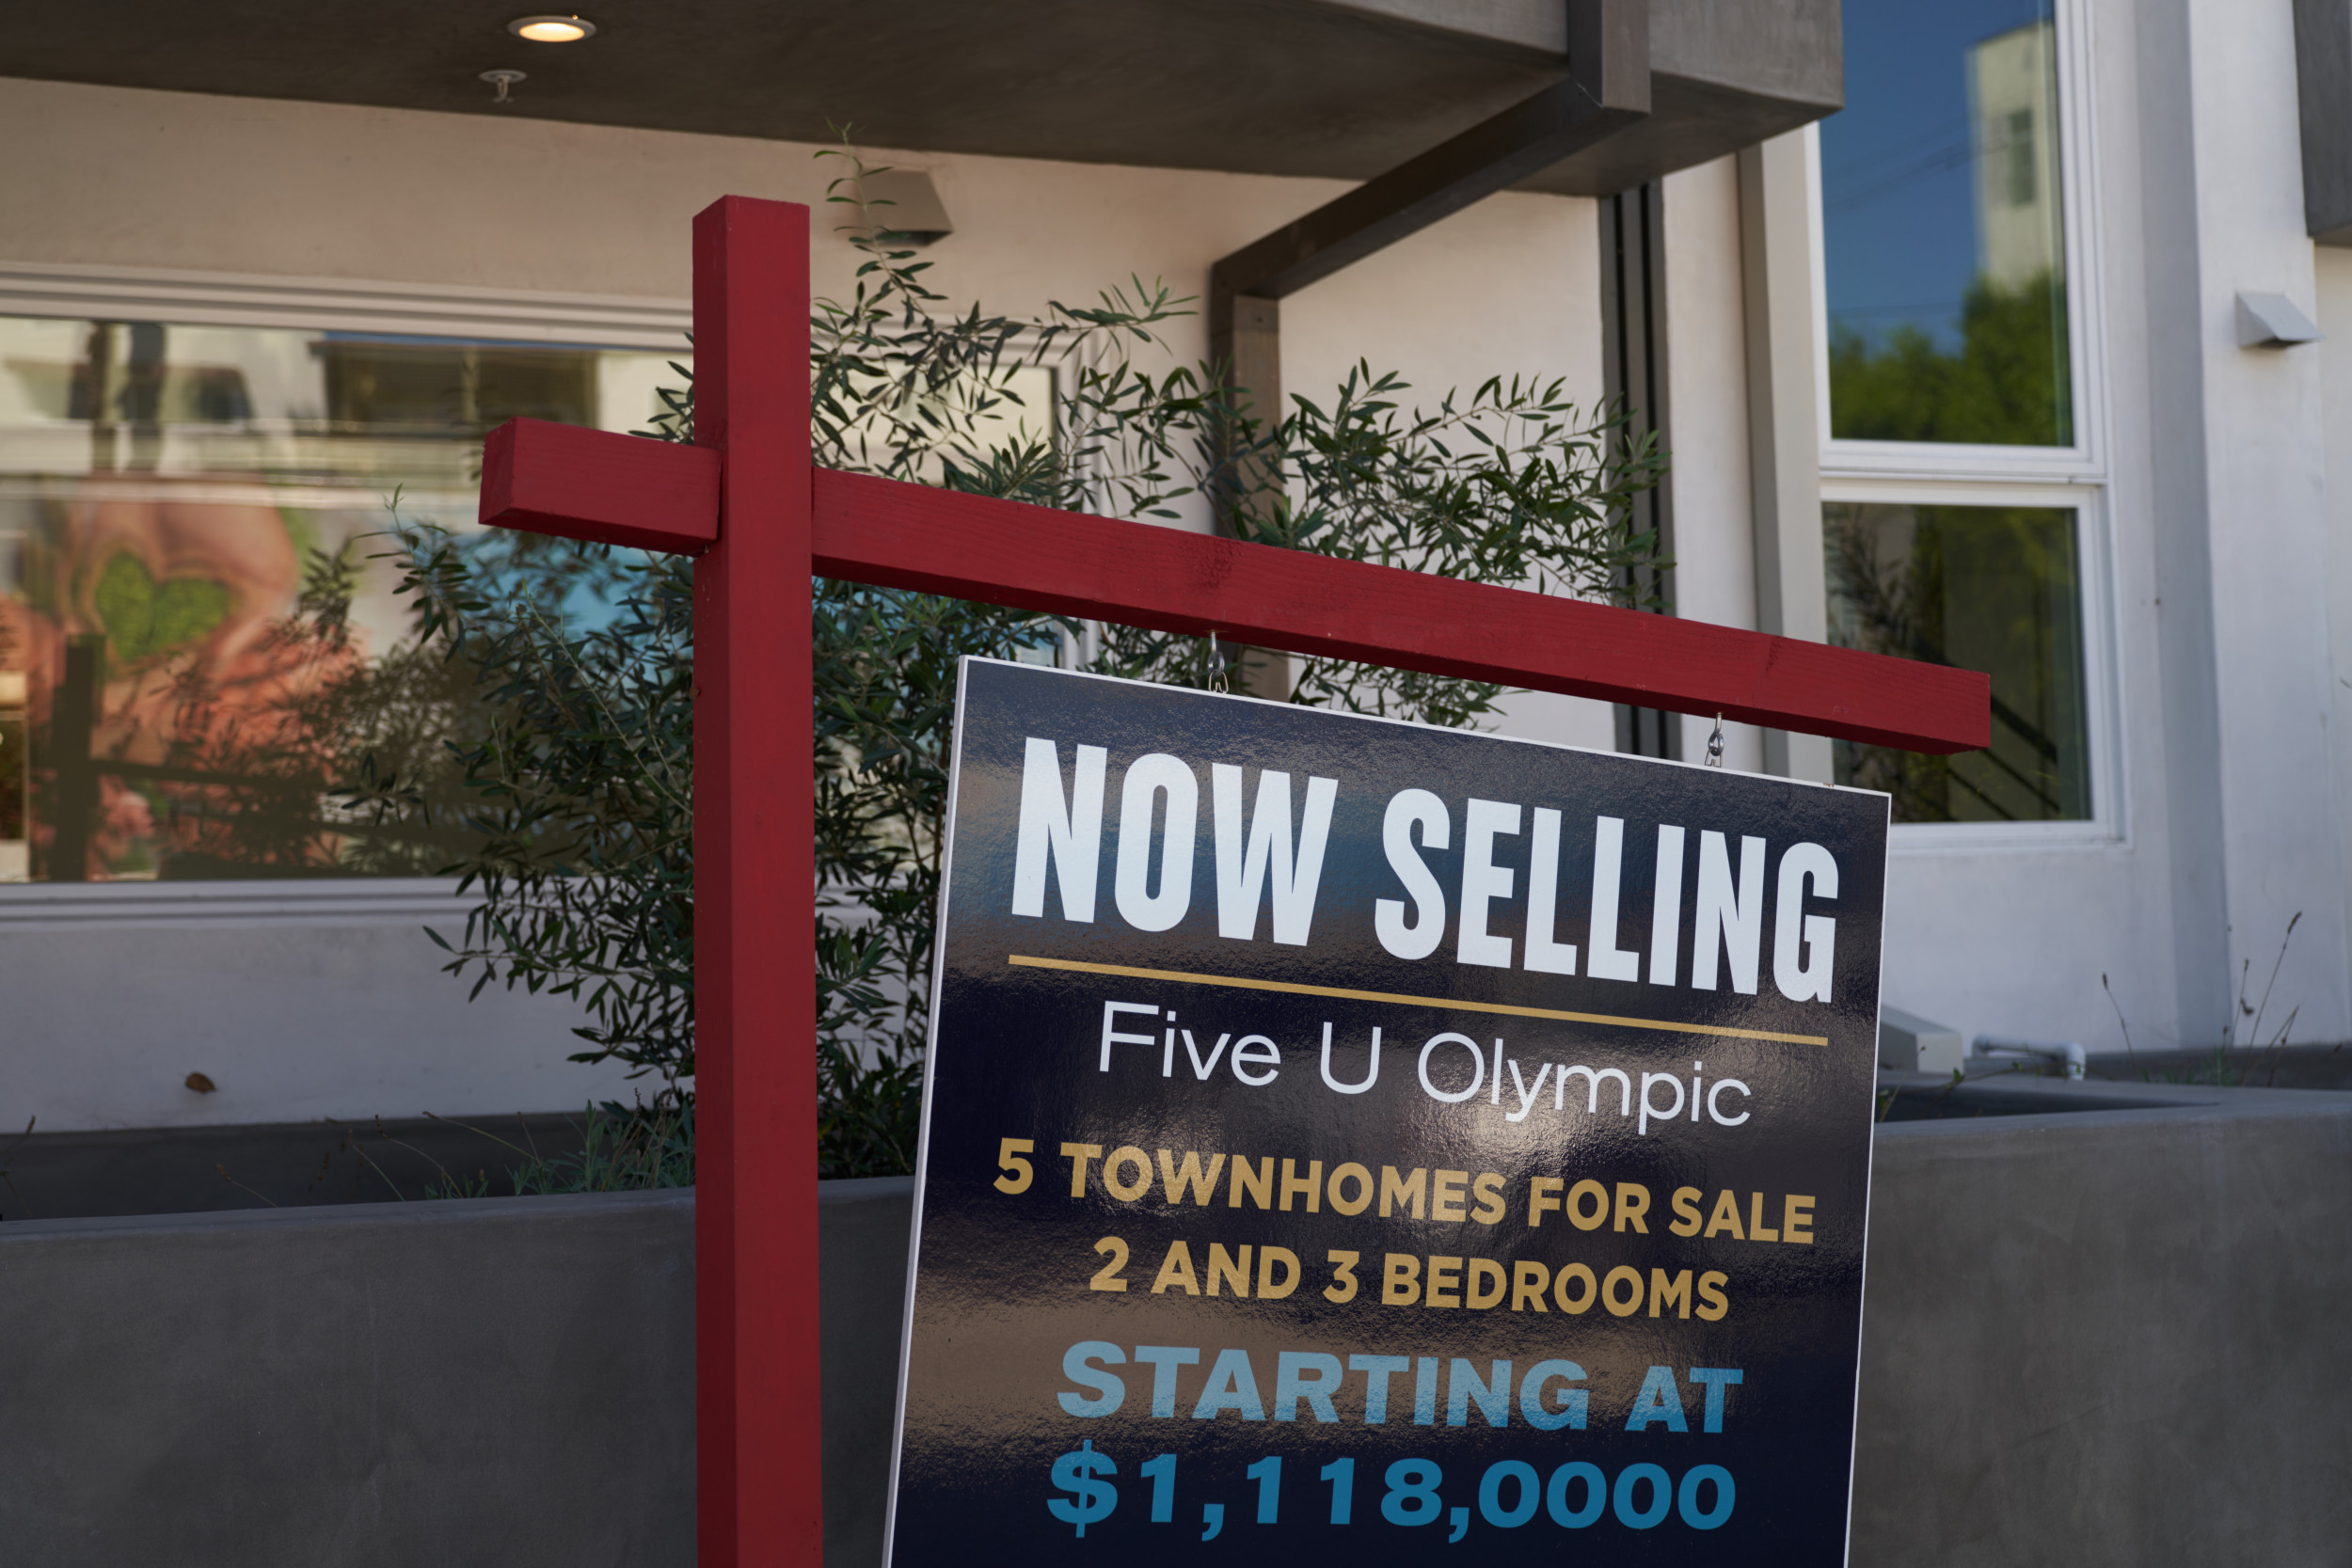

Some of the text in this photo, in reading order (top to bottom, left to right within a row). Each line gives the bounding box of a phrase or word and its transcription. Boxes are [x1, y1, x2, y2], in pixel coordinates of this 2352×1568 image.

[1011, 737, 1838, 1003] NOW SELLING
[1100, 1000, 1752, 1134] Five U Olympic
[993, 1138, 1816, 1244] 5 TOWNHOMES FOR SALE
[1089, 1237, 1729, 1322] 2 AND 3 BEDROOMS
[1057, 1340, 1743, 1433] STARTING AT
[1046, 1439, 1736, 1544] $1,118,0000
